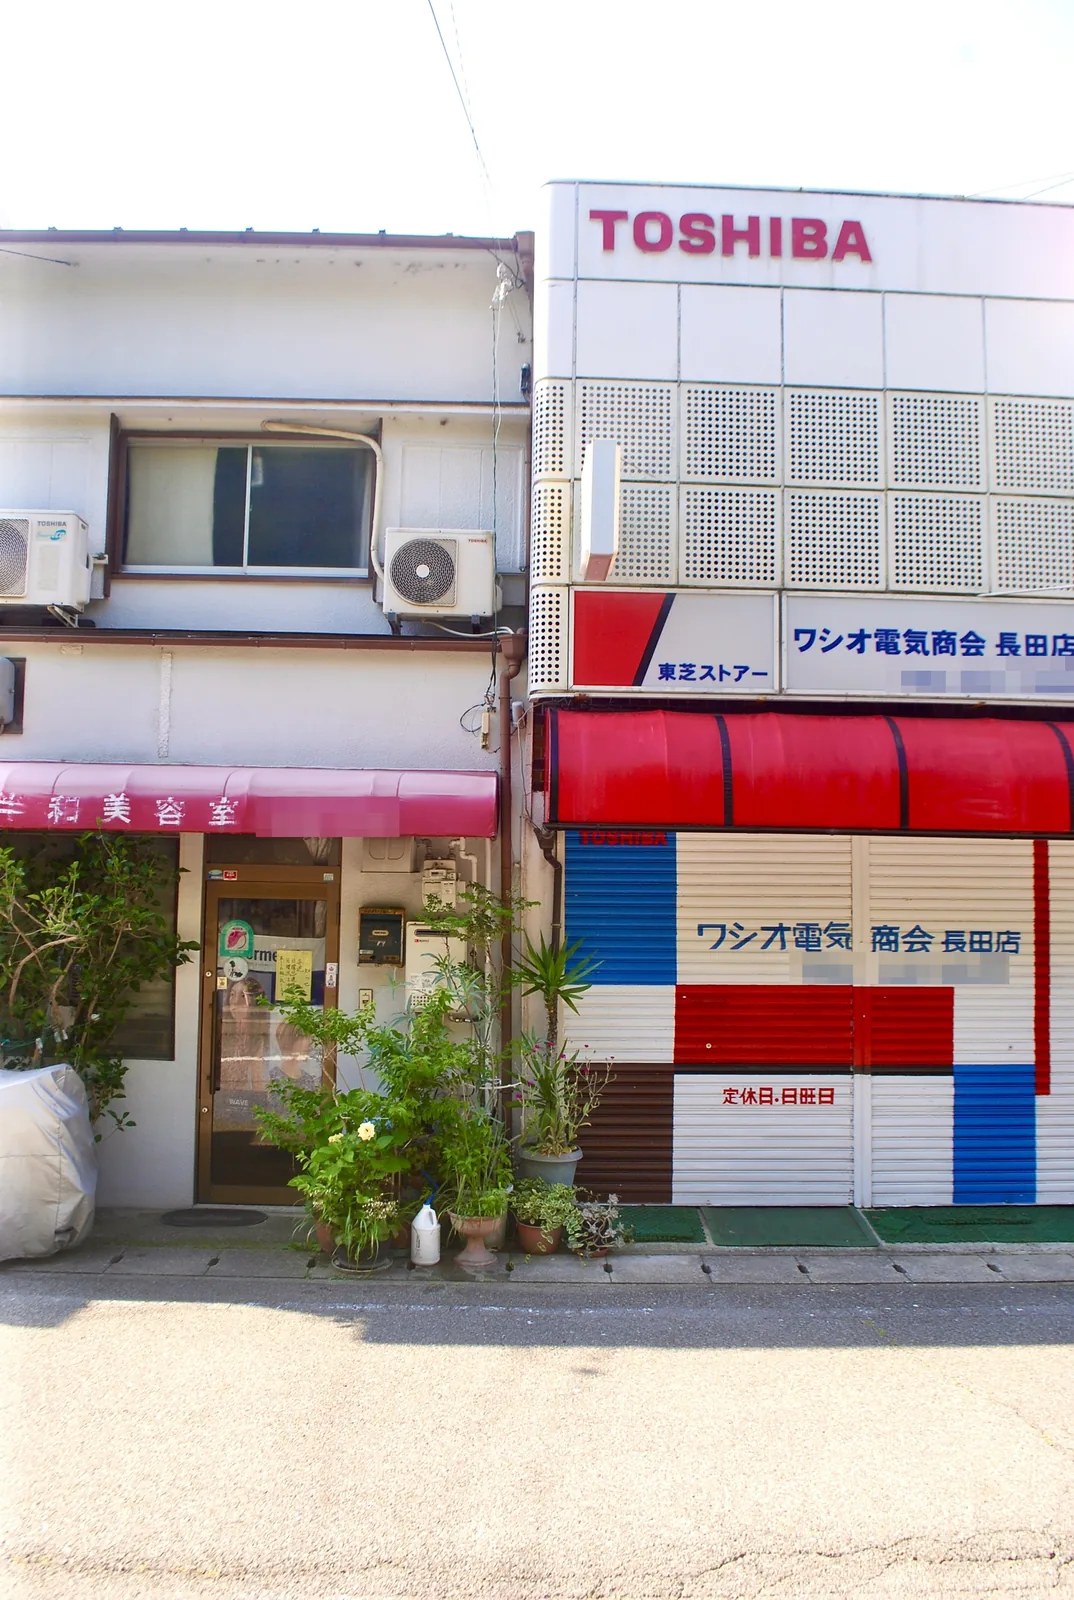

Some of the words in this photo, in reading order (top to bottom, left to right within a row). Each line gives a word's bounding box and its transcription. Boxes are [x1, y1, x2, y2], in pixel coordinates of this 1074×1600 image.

[589, 210, 873, 263] TOSHIBA
[794, 628, 987, 656] ワシオ電気商会
[995, 632, 1074, 656] 長田店
[658, 662, 768, 682] 東芝ストアー
[579, 831, 668, 846] TOSHIBA
[697, 921, 935, 952] ワシオ電気商会
[941, 930, 1021, 954] 長田店
